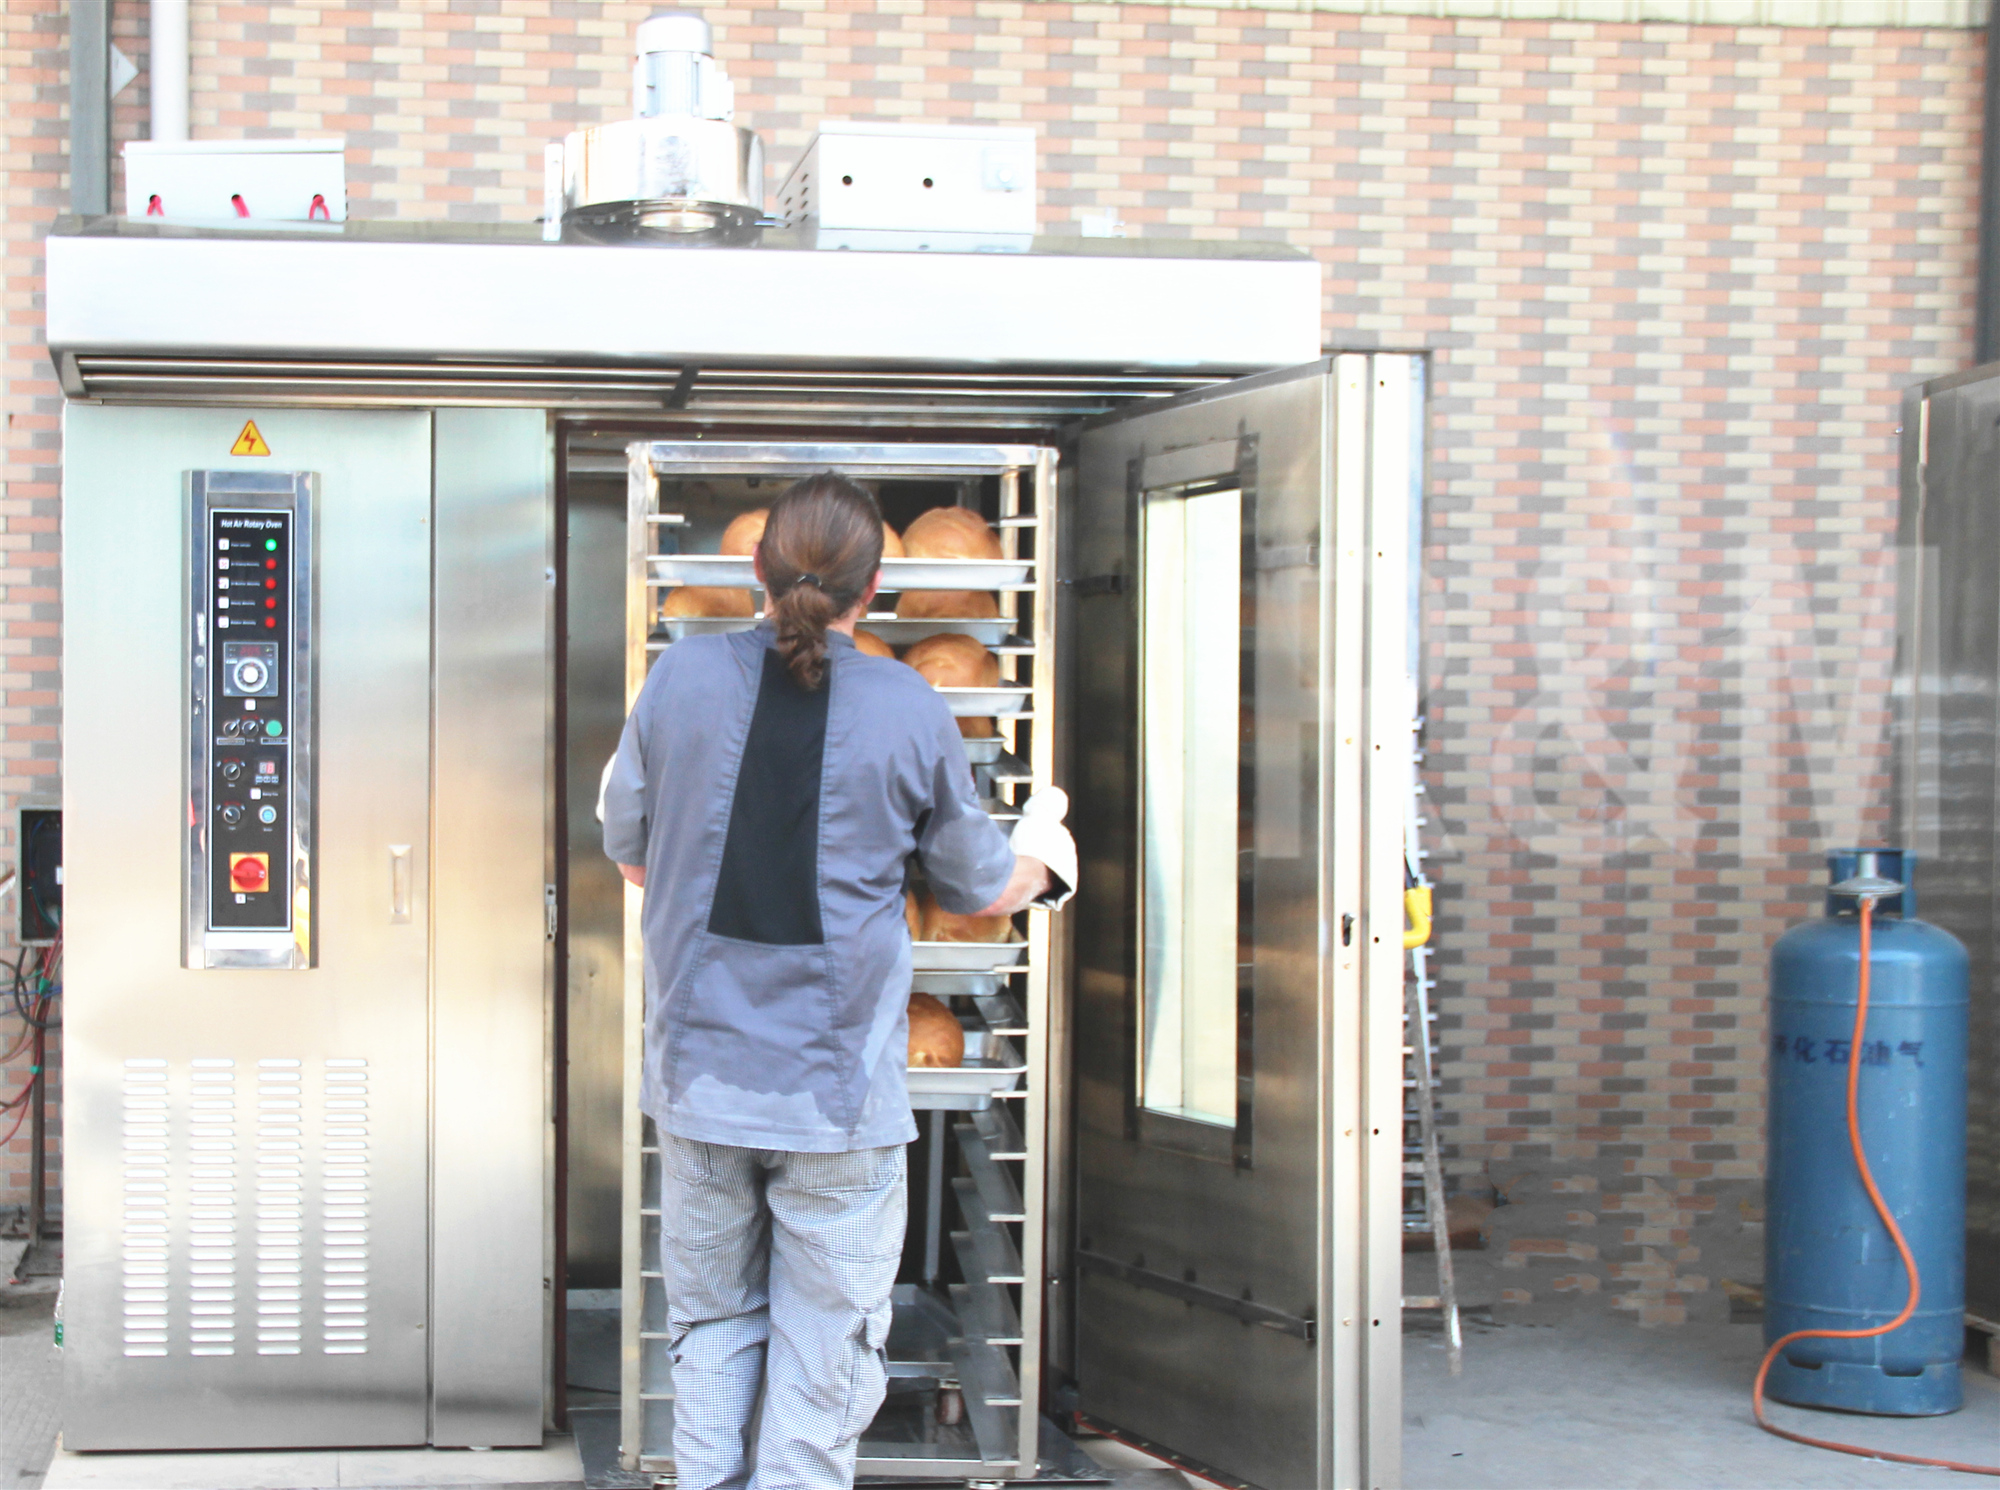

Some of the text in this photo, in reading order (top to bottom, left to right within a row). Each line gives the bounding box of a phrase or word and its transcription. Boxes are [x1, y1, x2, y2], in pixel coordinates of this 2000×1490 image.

[221, 519, 283, 530] Hot Air Rotary Oven
